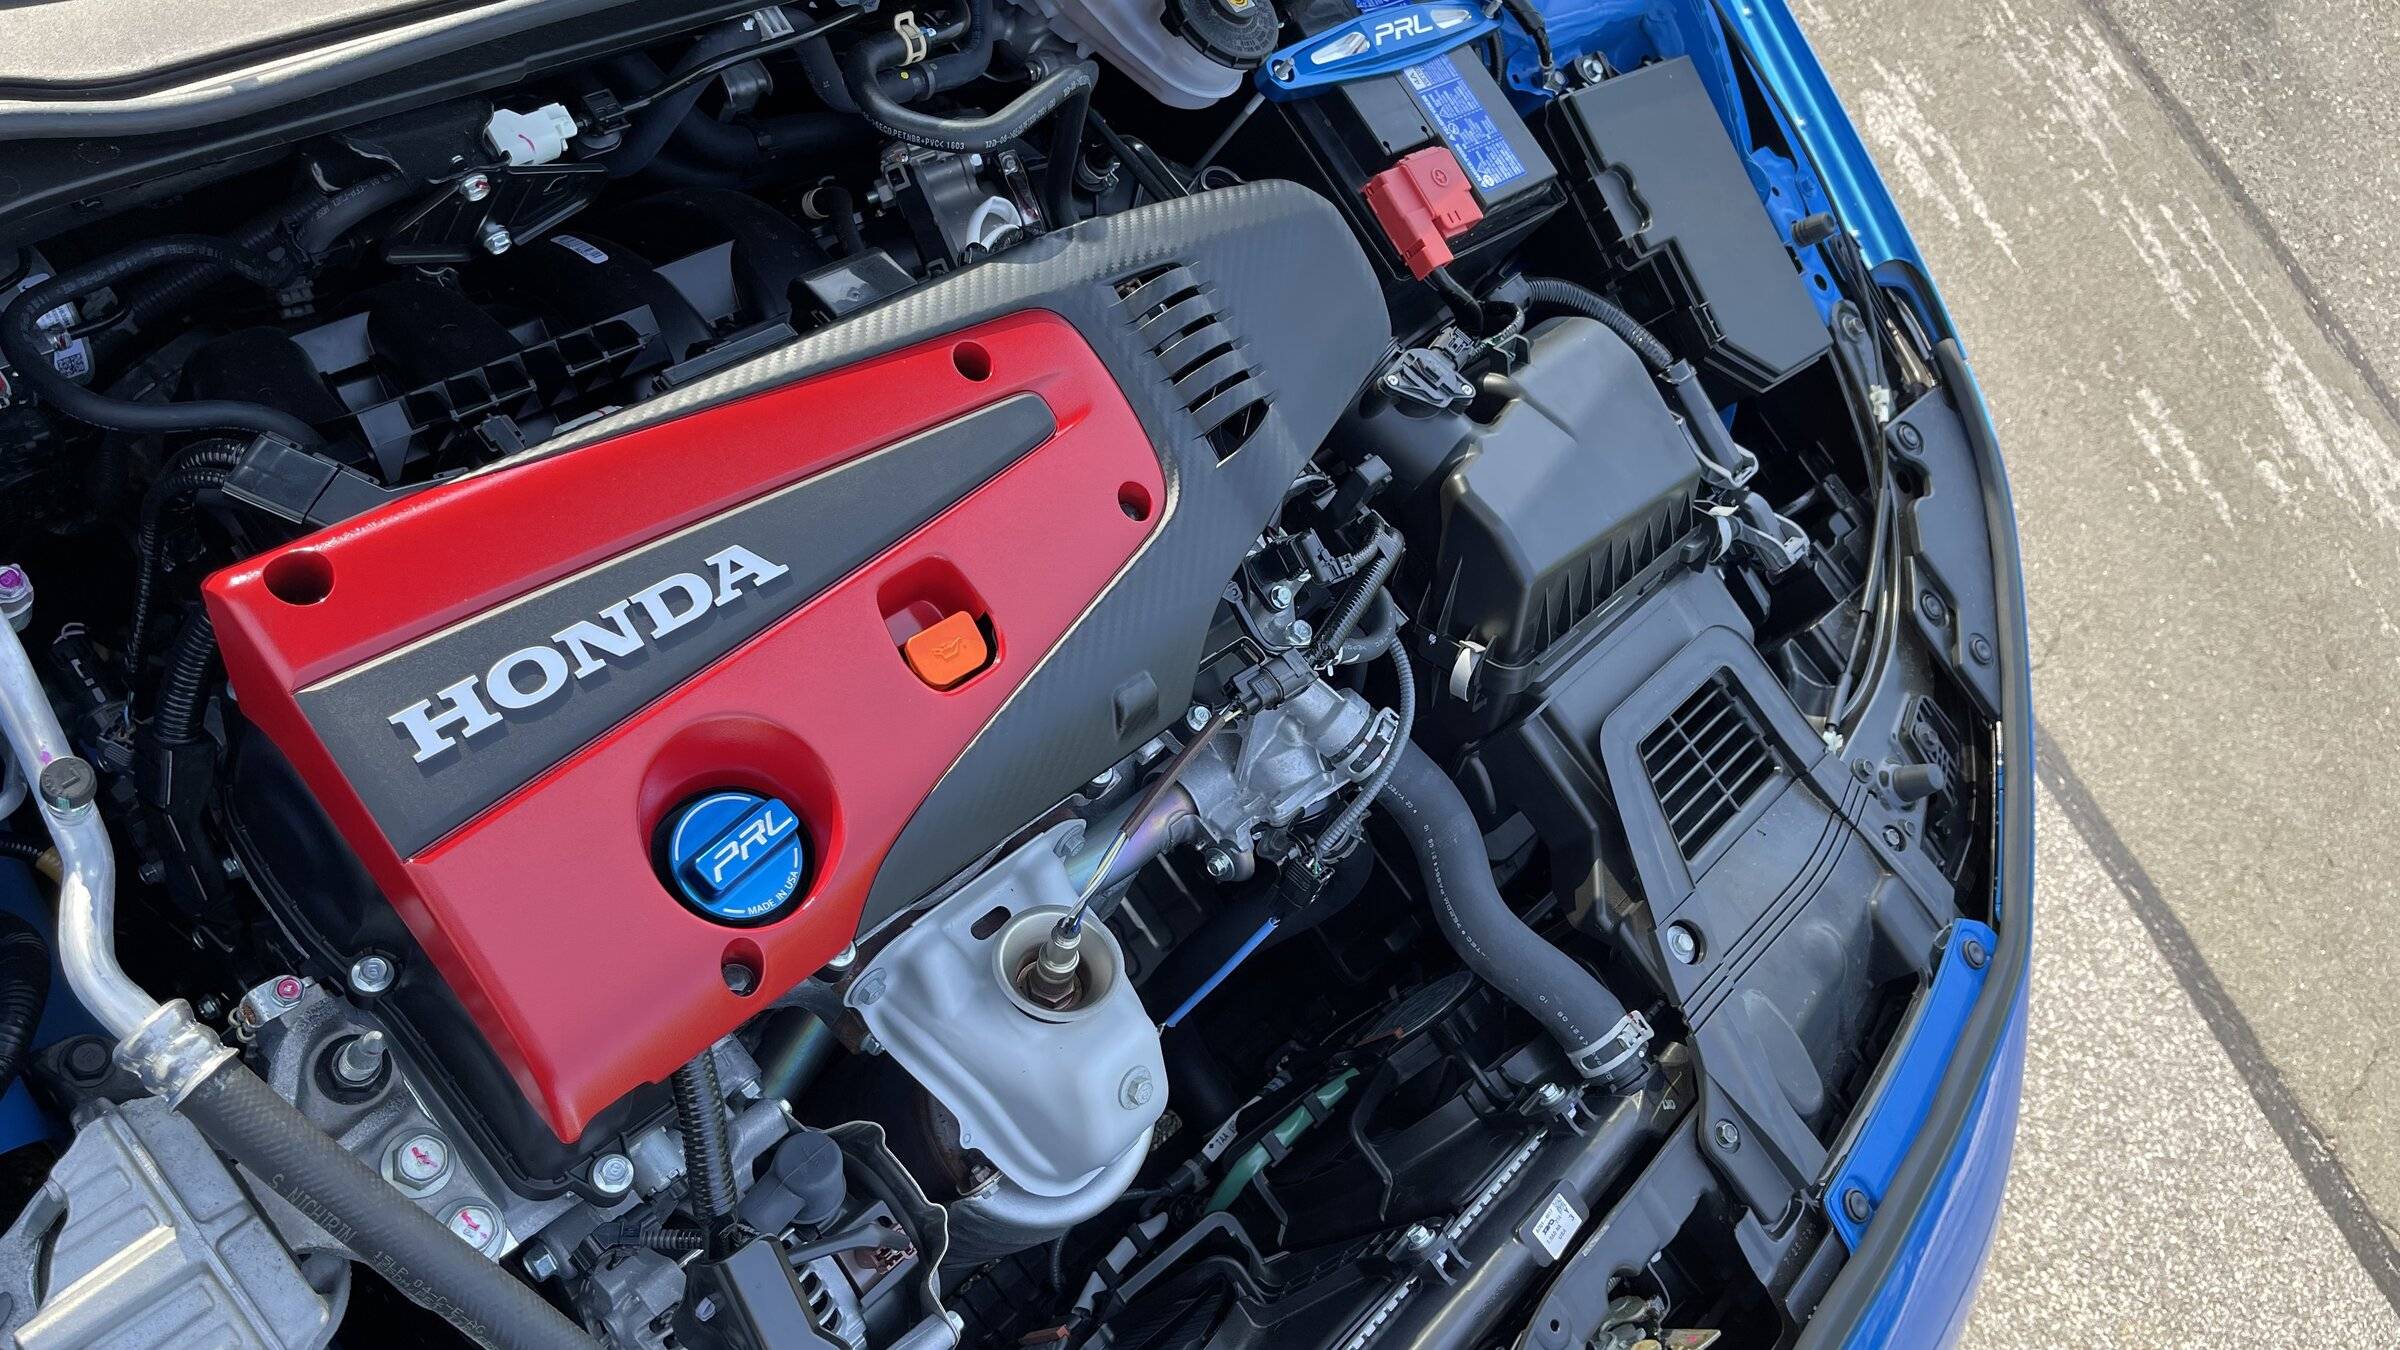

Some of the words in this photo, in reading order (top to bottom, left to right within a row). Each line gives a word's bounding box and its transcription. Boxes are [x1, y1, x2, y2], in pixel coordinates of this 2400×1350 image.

[1375, 14, 1433, 46] PRL
[387, 544, 789, 764] HONDA
[713, 810, 793, 882] PRL
[748, 898, 776, 915] MADE
[775, 889, 788, 901] IN
[786, 871, 800, 890] USA
